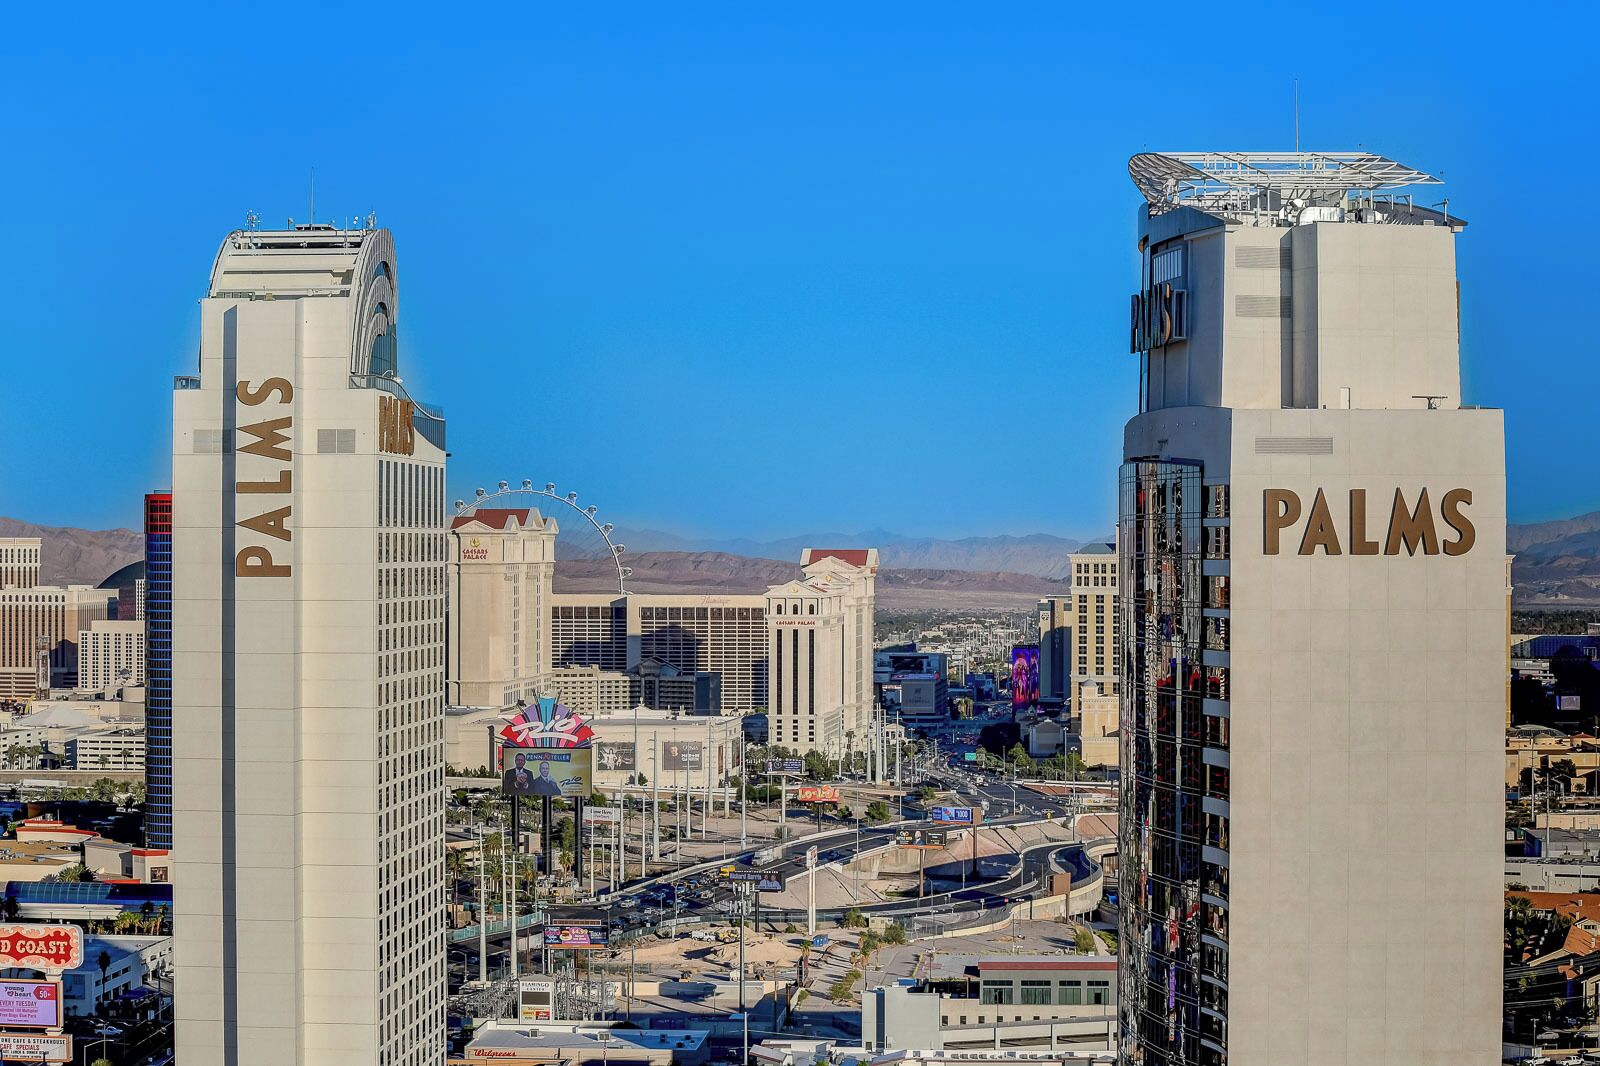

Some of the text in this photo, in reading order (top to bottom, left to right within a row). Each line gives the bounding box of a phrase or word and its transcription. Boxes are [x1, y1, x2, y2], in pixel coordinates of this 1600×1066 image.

[236, 377, 294, 577] PALMS
[1263, 487, 1476, 557] PALMS
[511, 714, 578, 743] Rio
[1, 940, 68, 954] D COAST
[39, 990, 51, 998] 50+
[474, 1049, 517, 1058] Walgreens
